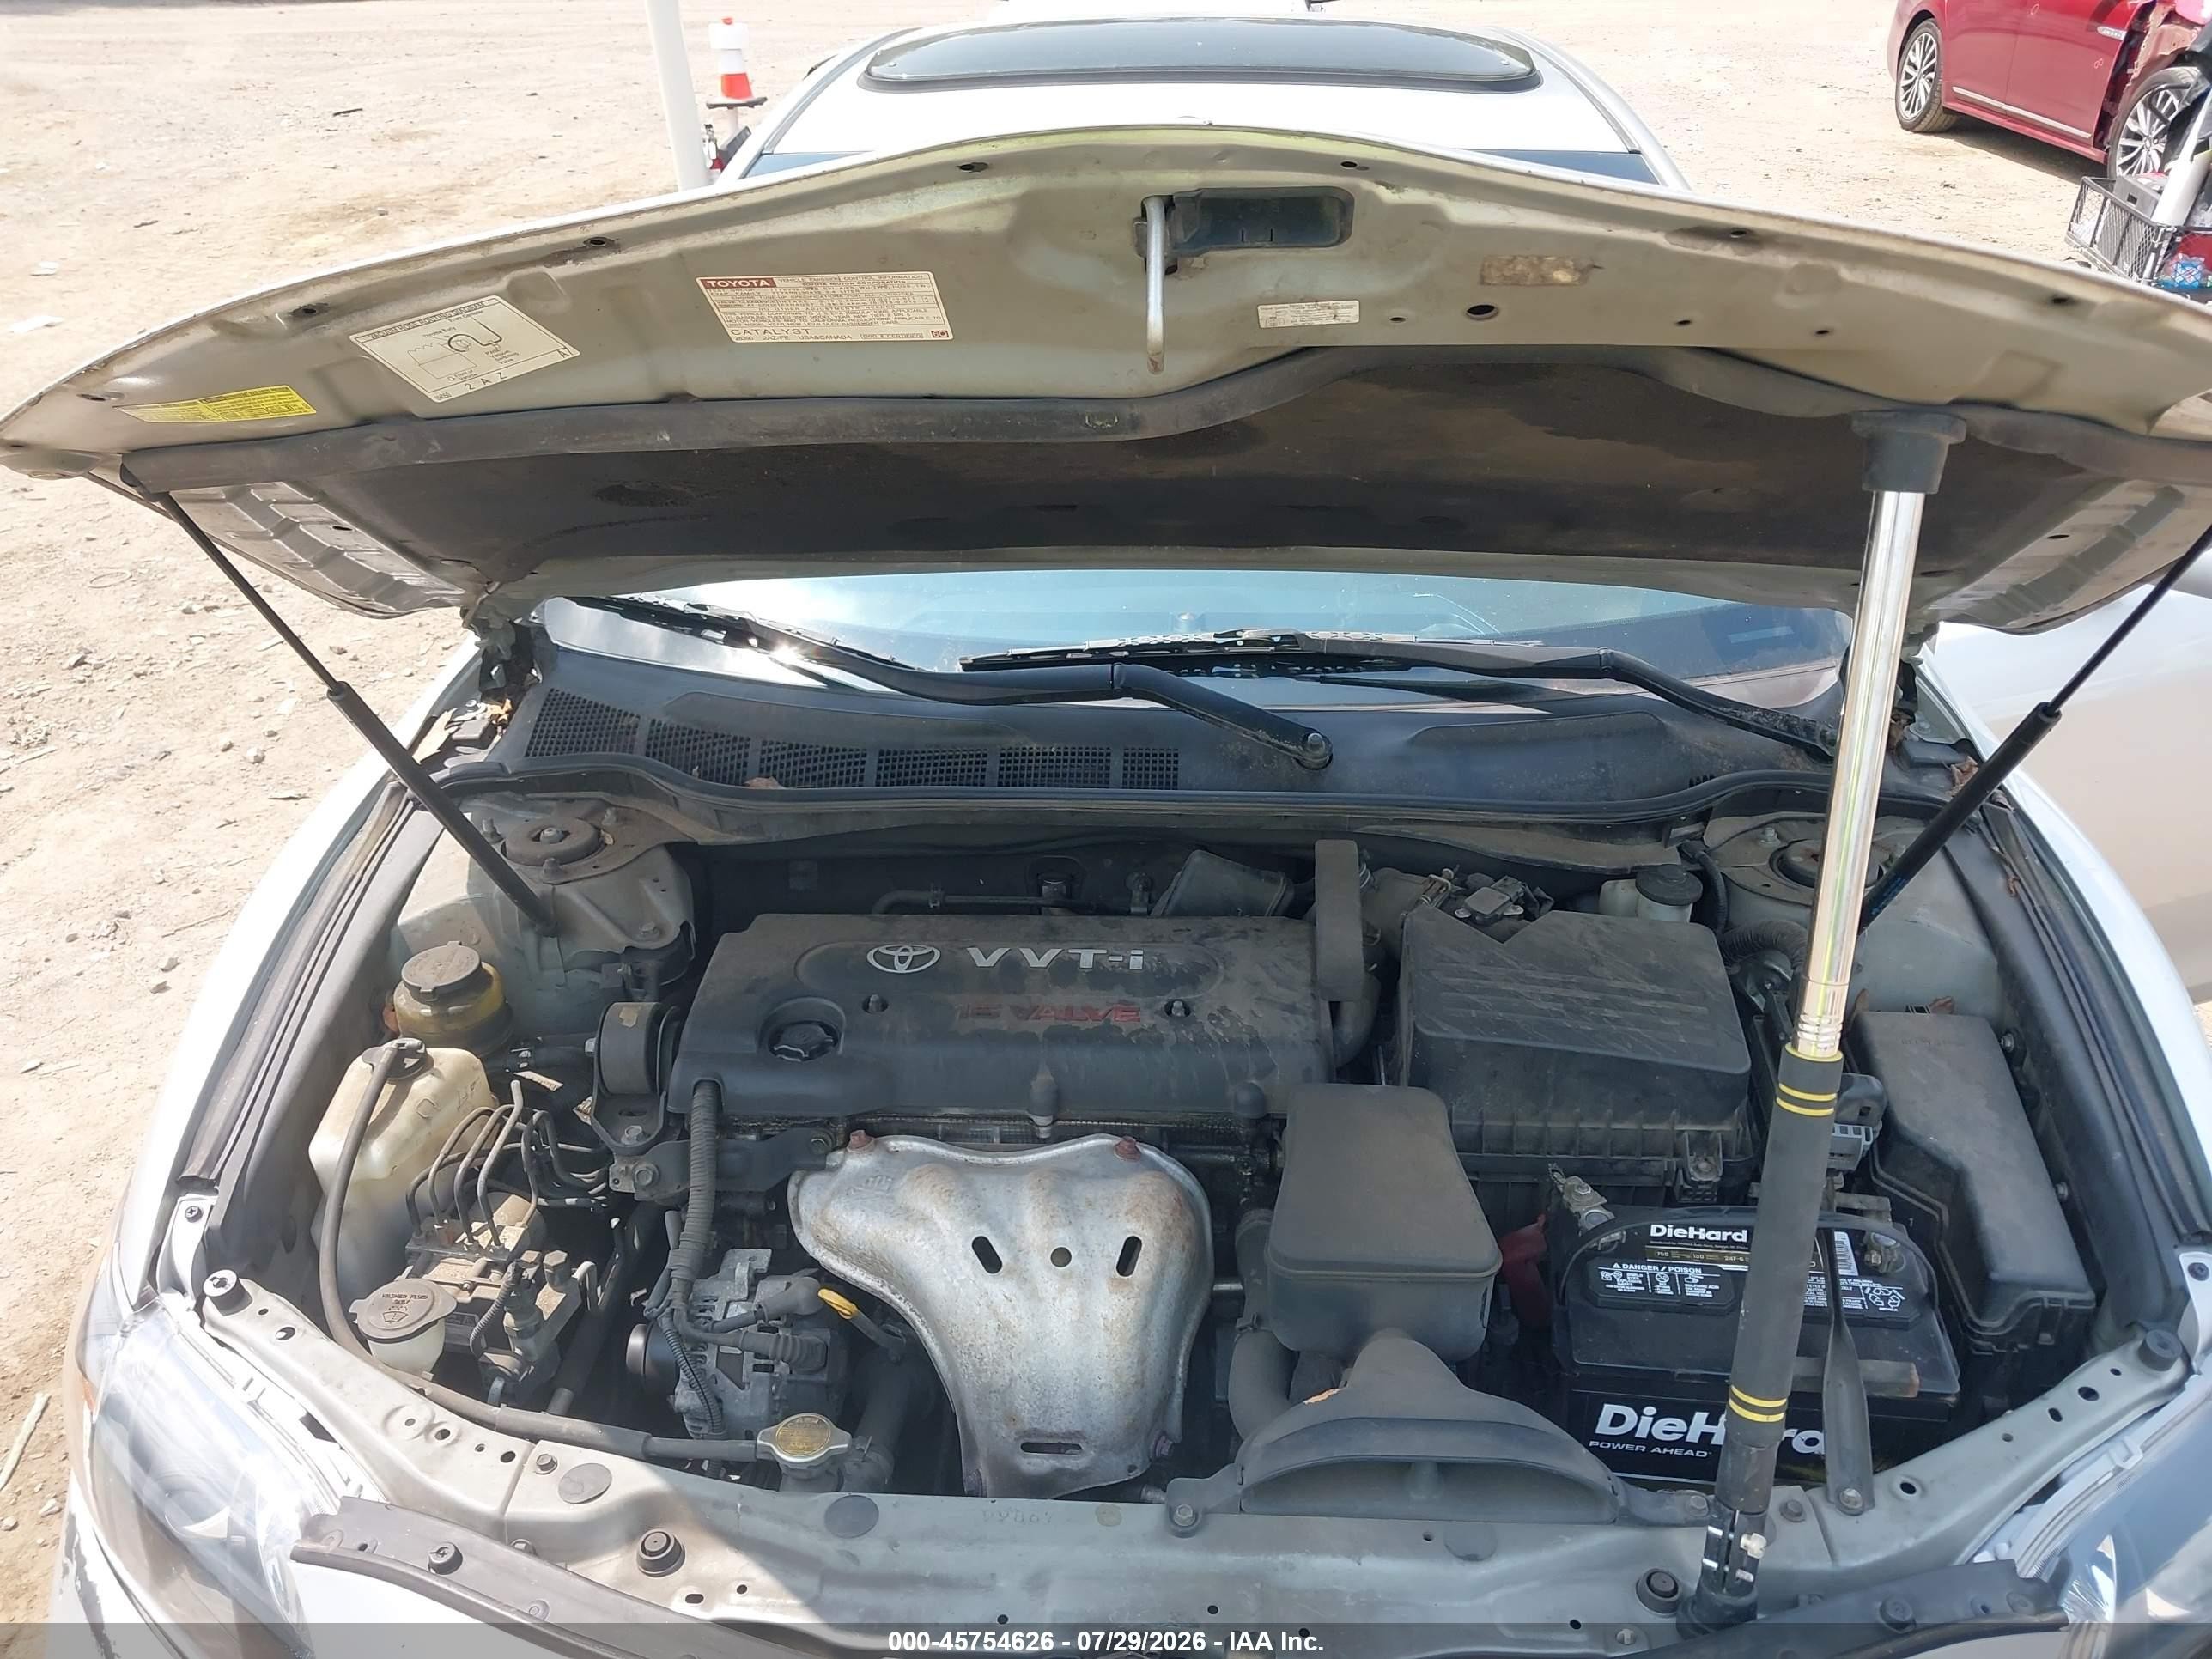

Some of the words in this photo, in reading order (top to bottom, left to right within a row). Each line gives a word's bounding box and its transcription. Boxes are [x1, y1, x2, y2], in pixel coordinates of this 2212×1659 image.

[707, 279, 771, 288] TOYOTA
[966, 946, 1145, 969] VVT-i
[1009, 1000, 1141, 1023] VALVE
[1650, 1224, 1748, 1243] DieHard
[1621, 1263, 1660, 1273] DANGER
[1668, 1266, 1702, 1274] POISON
[1595, 1403, 1826, 1455] DieHrd
[1589, 1440, 1646, 1453] POWER
[1650, 1446, 1709, 1458] AHEAD
